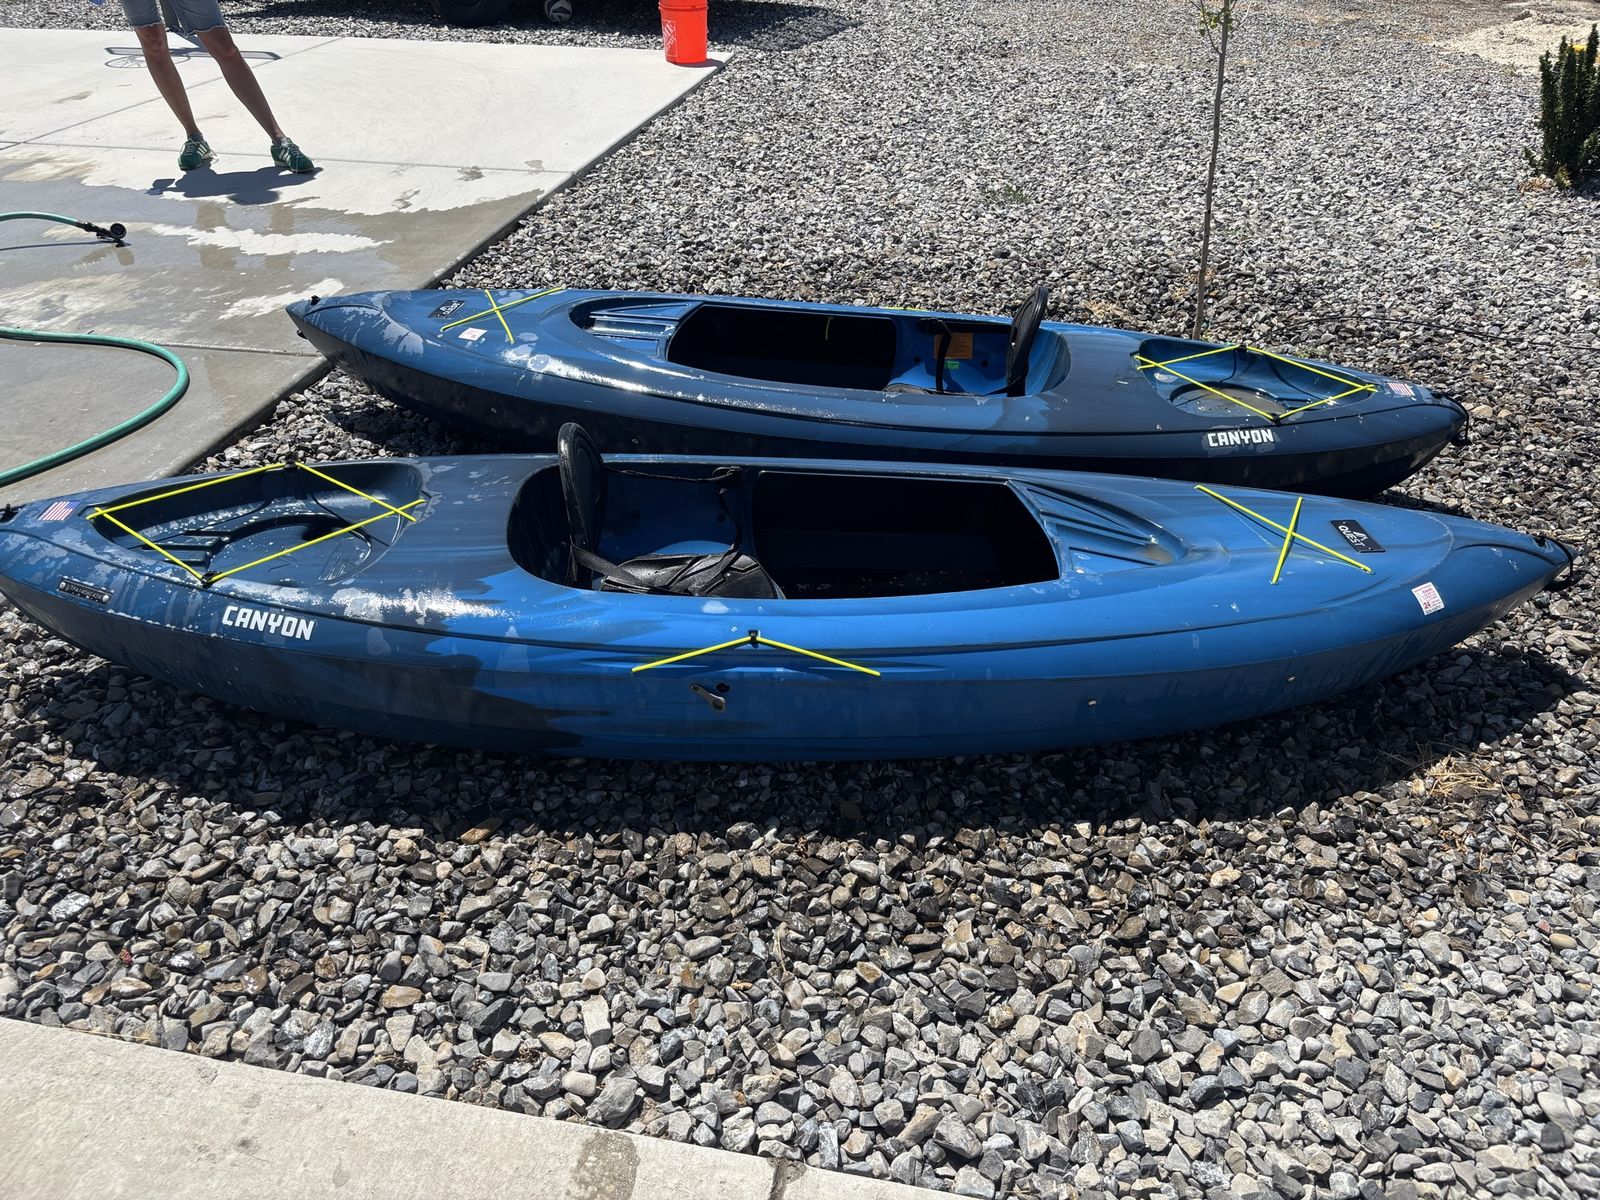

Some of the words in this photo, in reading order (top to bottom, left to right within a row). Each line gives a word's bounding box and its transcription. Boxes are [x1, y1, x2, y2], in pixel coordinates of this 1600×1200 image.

[1207, 429, 1275, 447] CANYON
[1338, 525, 1366, 547] QUEST
[221, 604, 316, 642] CANYON
